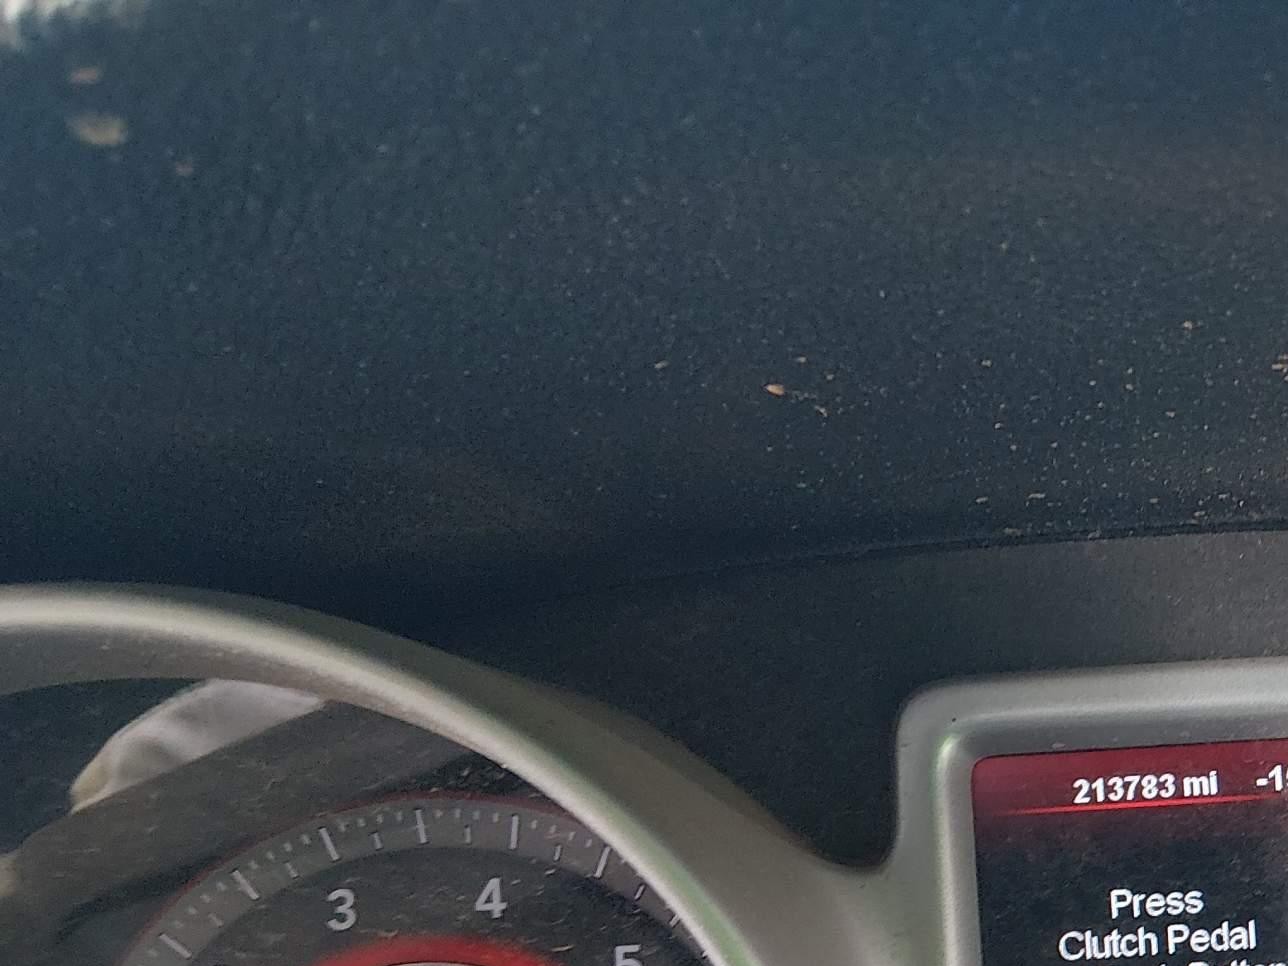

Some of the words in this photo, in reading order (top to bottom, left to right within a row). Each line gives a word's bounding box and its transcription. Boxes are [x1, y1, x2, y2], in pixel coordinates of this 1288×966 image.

[1073, 774, 1176, 804] 213783
[1183, 770, 1219, 797] mi
[326, 889, 357, 931] 3
[475, 878, 507, 919] 4
[1110, 888, 1204, 919] Press
[1058, 929, 1158, 961] Clutch
[1168, 921, 1257, 955] Pedal
